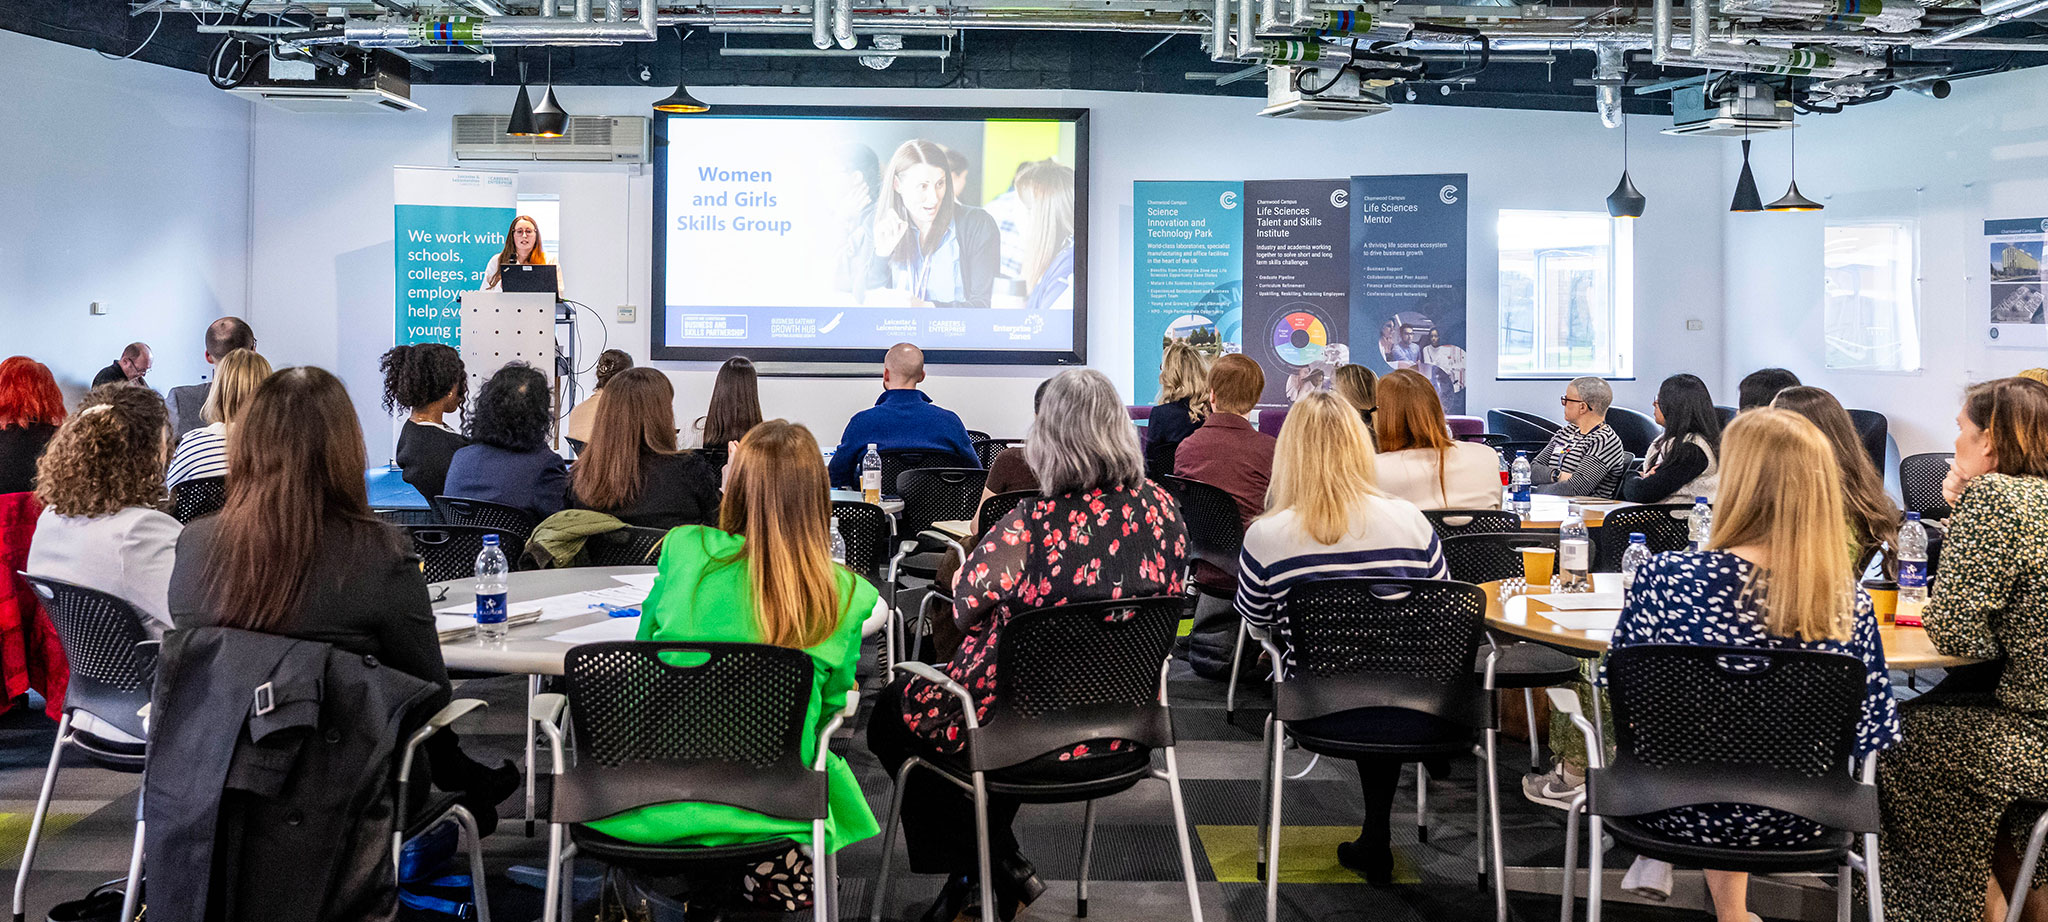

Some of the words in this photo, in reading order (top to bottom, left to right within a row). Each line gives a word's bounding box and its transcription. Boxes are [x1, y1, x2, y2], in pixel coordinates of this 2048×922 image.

[698, 166, 772, 182] Women
[692, 191, 727, 206] and
[735, 192, 777, 207] Girls
[1148, 208, 1178, 216] Science
[1257, 207, 1271, 215] Life
[1274, 207, 1310, 215] Sciences
[1364, 203, 1379, 212] Life
[1381, 203, 1418, 212] Sciences
[1148, 218, 1188, 227] Innovation
[1191, 218, 1206, 227] and
[1257, 218, 1281, 226] Talent
[1283, 218, 1298, 226] and
[1300, 218, 1322, 226] Skills
[1364, 215, 1392, 224] Mentor
[677, 215, 726, 231] Skills
[733, 216, 792, 236] Group
[408, 230, 432, 242] We
[436, 230, 470, 243] work
[475, 232, 504, 244] with
[1148, 229, 1192, 239] Technology
[1195, 229, 1212, 238] Park
[1257, 229, 1289, 237] Institute
[408, 248, 464, 263] schools,
[408, 268, 467, 282] colleges,
[471, 271, 485, 280] an
[408, 304, 437, 319] help
[408, 326, 451, 338] young
[771, 325, 800, 333] GROWTH
[802, 325, 816, 333] HUB
